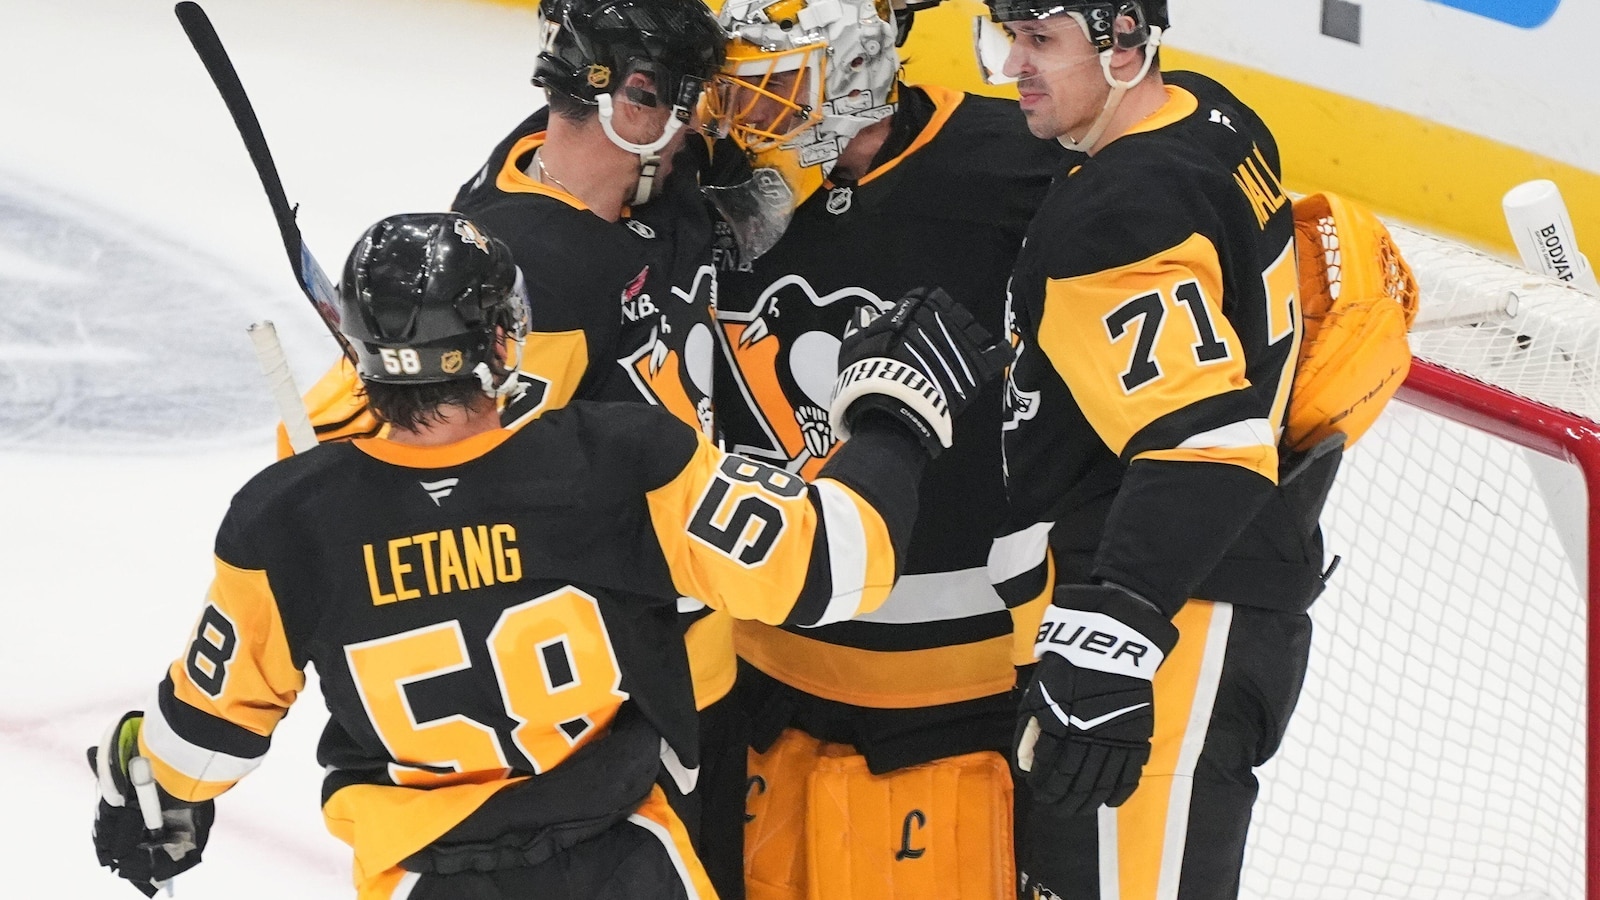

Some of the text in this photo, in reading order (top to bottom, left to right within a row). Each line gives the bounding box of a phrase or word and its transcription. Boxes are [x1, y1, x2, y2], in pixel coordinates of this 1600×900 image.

[379, 348, 422, 376] 58
[1101, 277, 1234, 396] 71
[363, 524, 522, 606] LETANG
[685, 452, 808, 569] 58
[343, 584, 631, 786] 58
